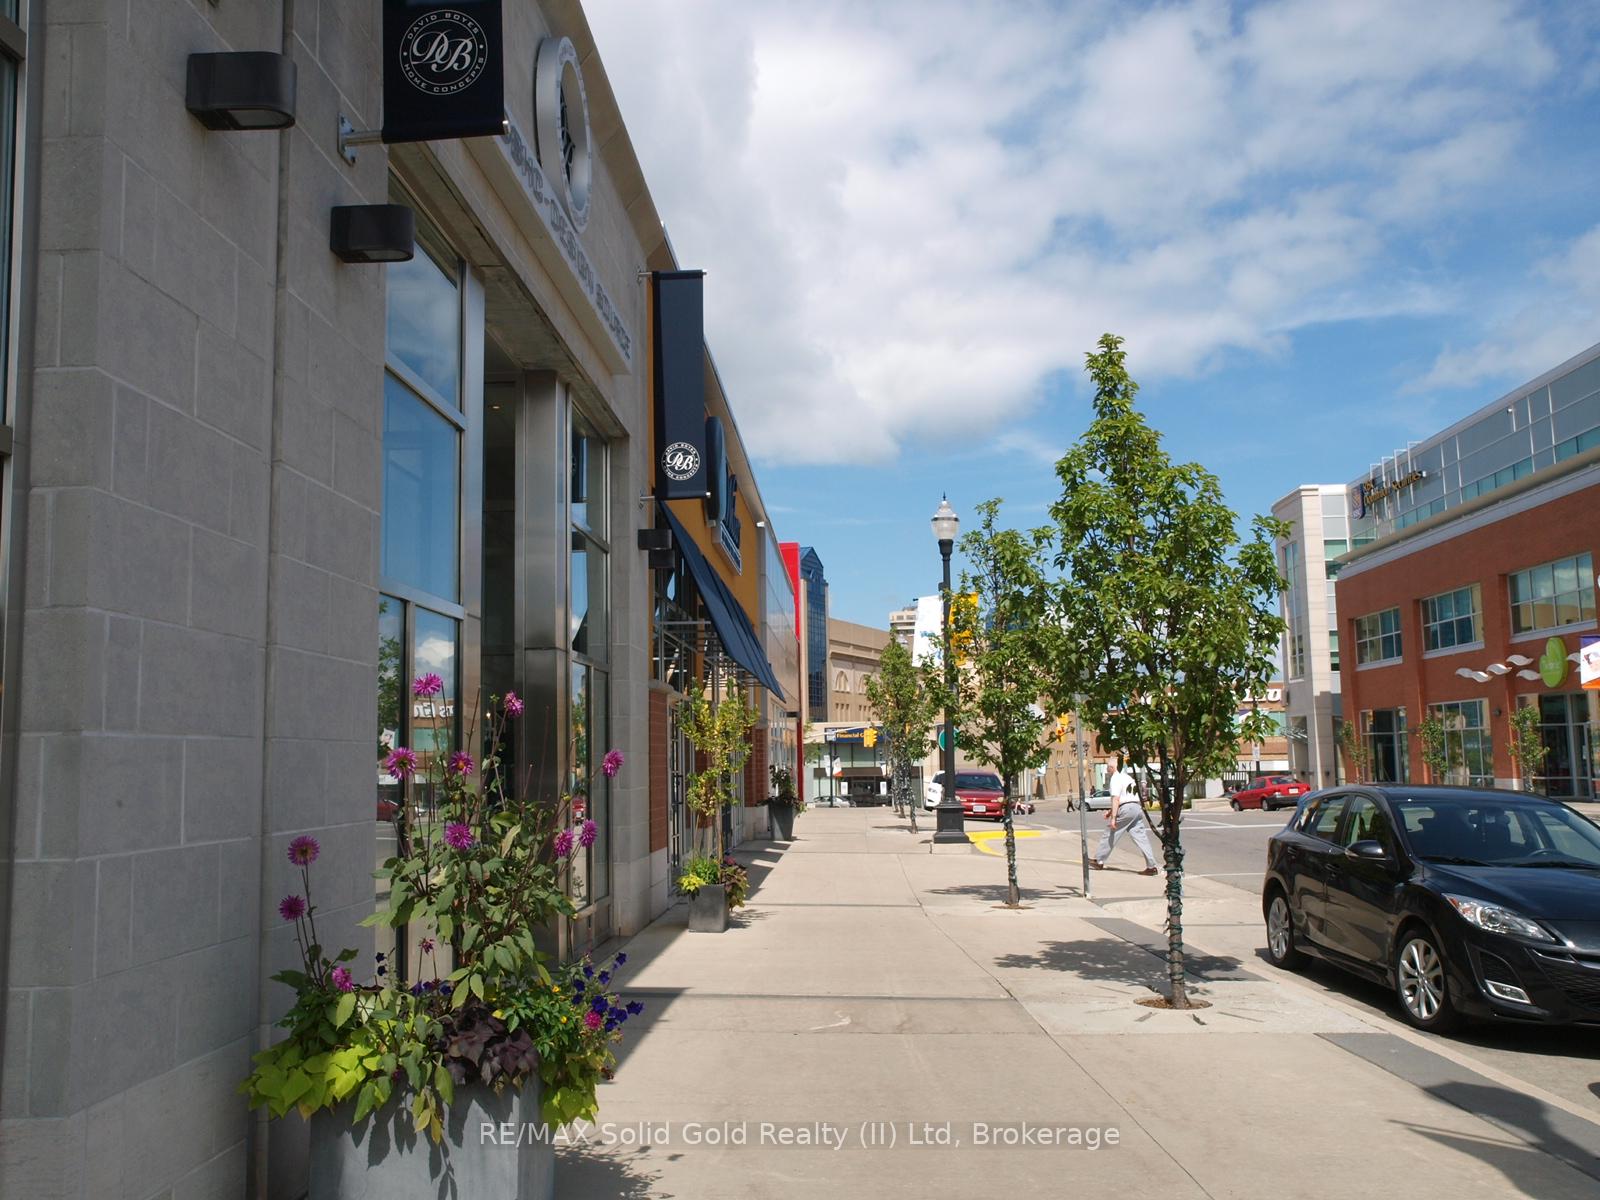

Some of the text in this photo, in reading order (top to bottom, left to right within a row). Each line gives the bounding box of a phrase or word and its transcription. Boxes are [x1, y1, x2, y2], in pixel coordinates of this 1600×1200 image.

[407, 12, 479, 39] DAVID BOYES
[404, 57, 484, 93] HOME CONCEPTS
